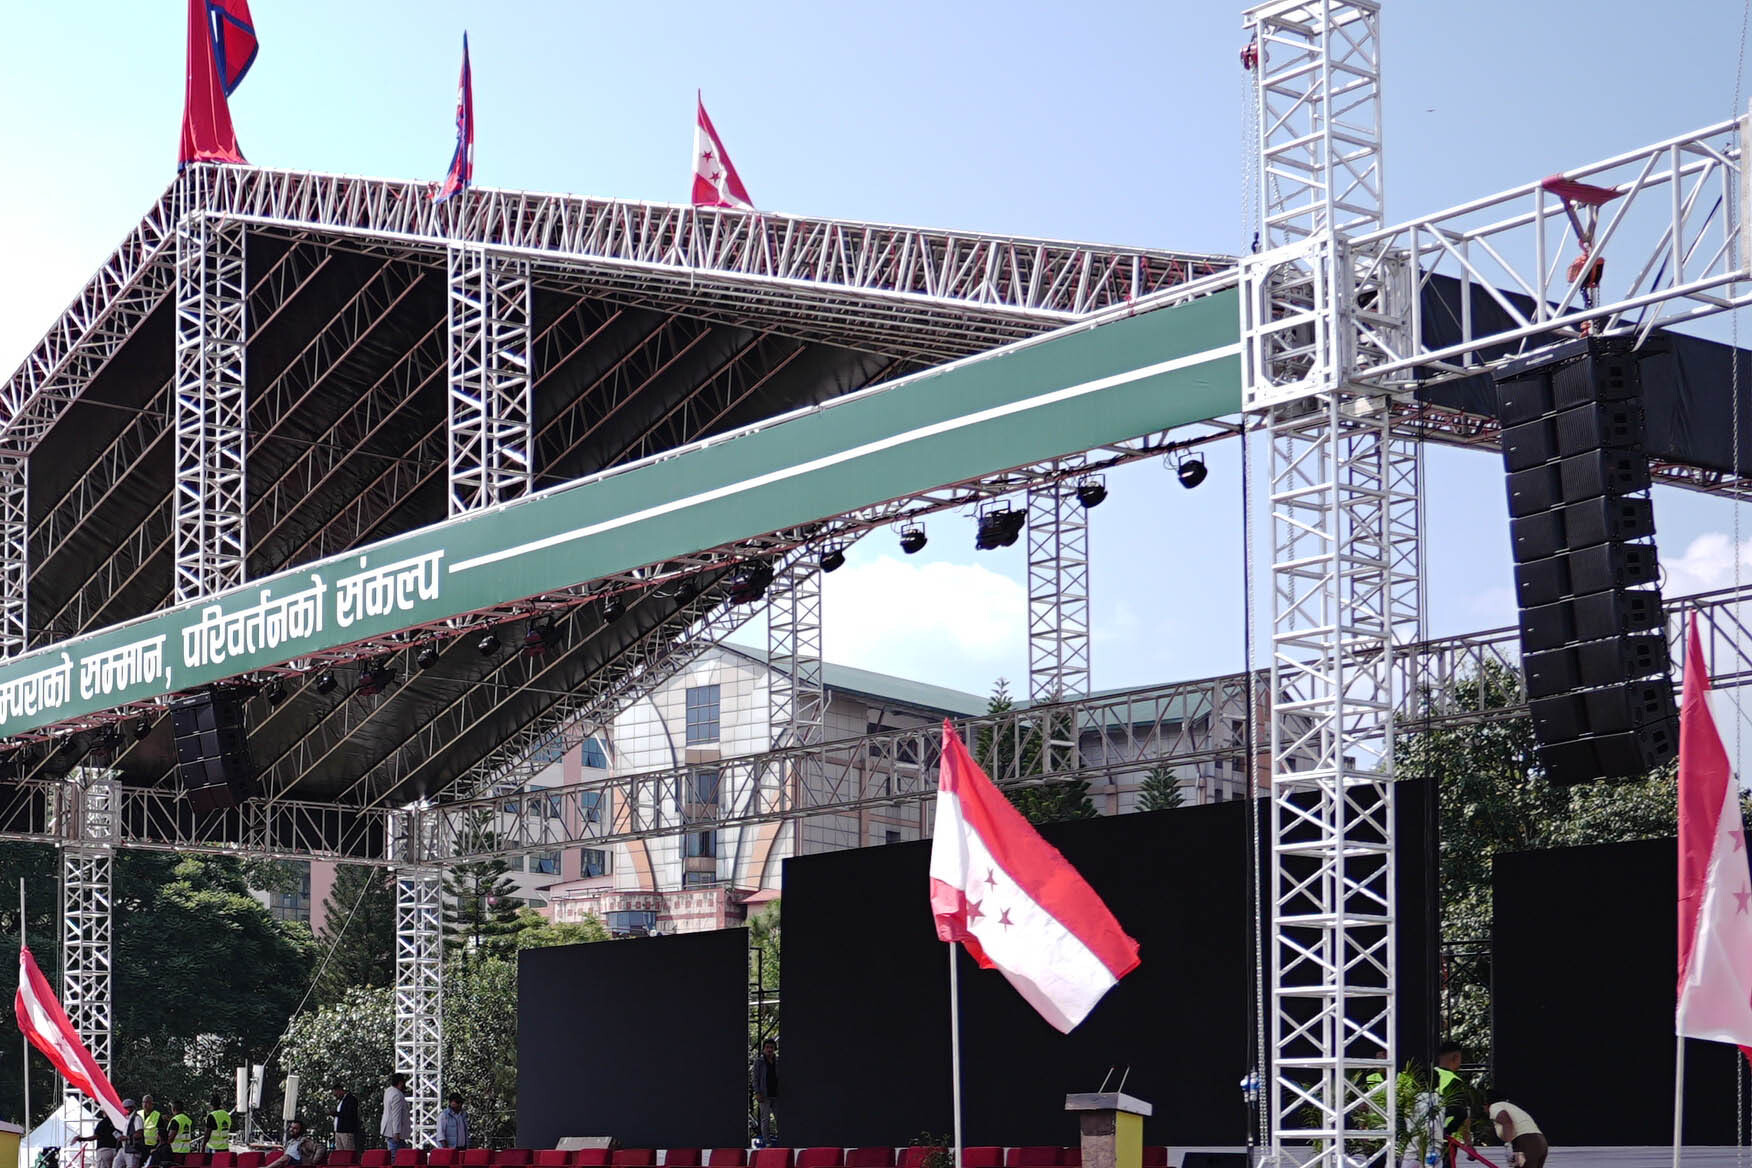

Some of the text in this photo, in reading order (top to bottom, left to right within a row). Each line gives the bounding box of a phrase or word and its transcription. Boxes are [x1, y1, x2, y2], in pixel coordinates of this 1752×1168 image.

[80, 633, 172, 700] सम्मान,
[182, 574, 327, 667] परिवर्तनको
[336, 550, 445, 628] संकल्प
